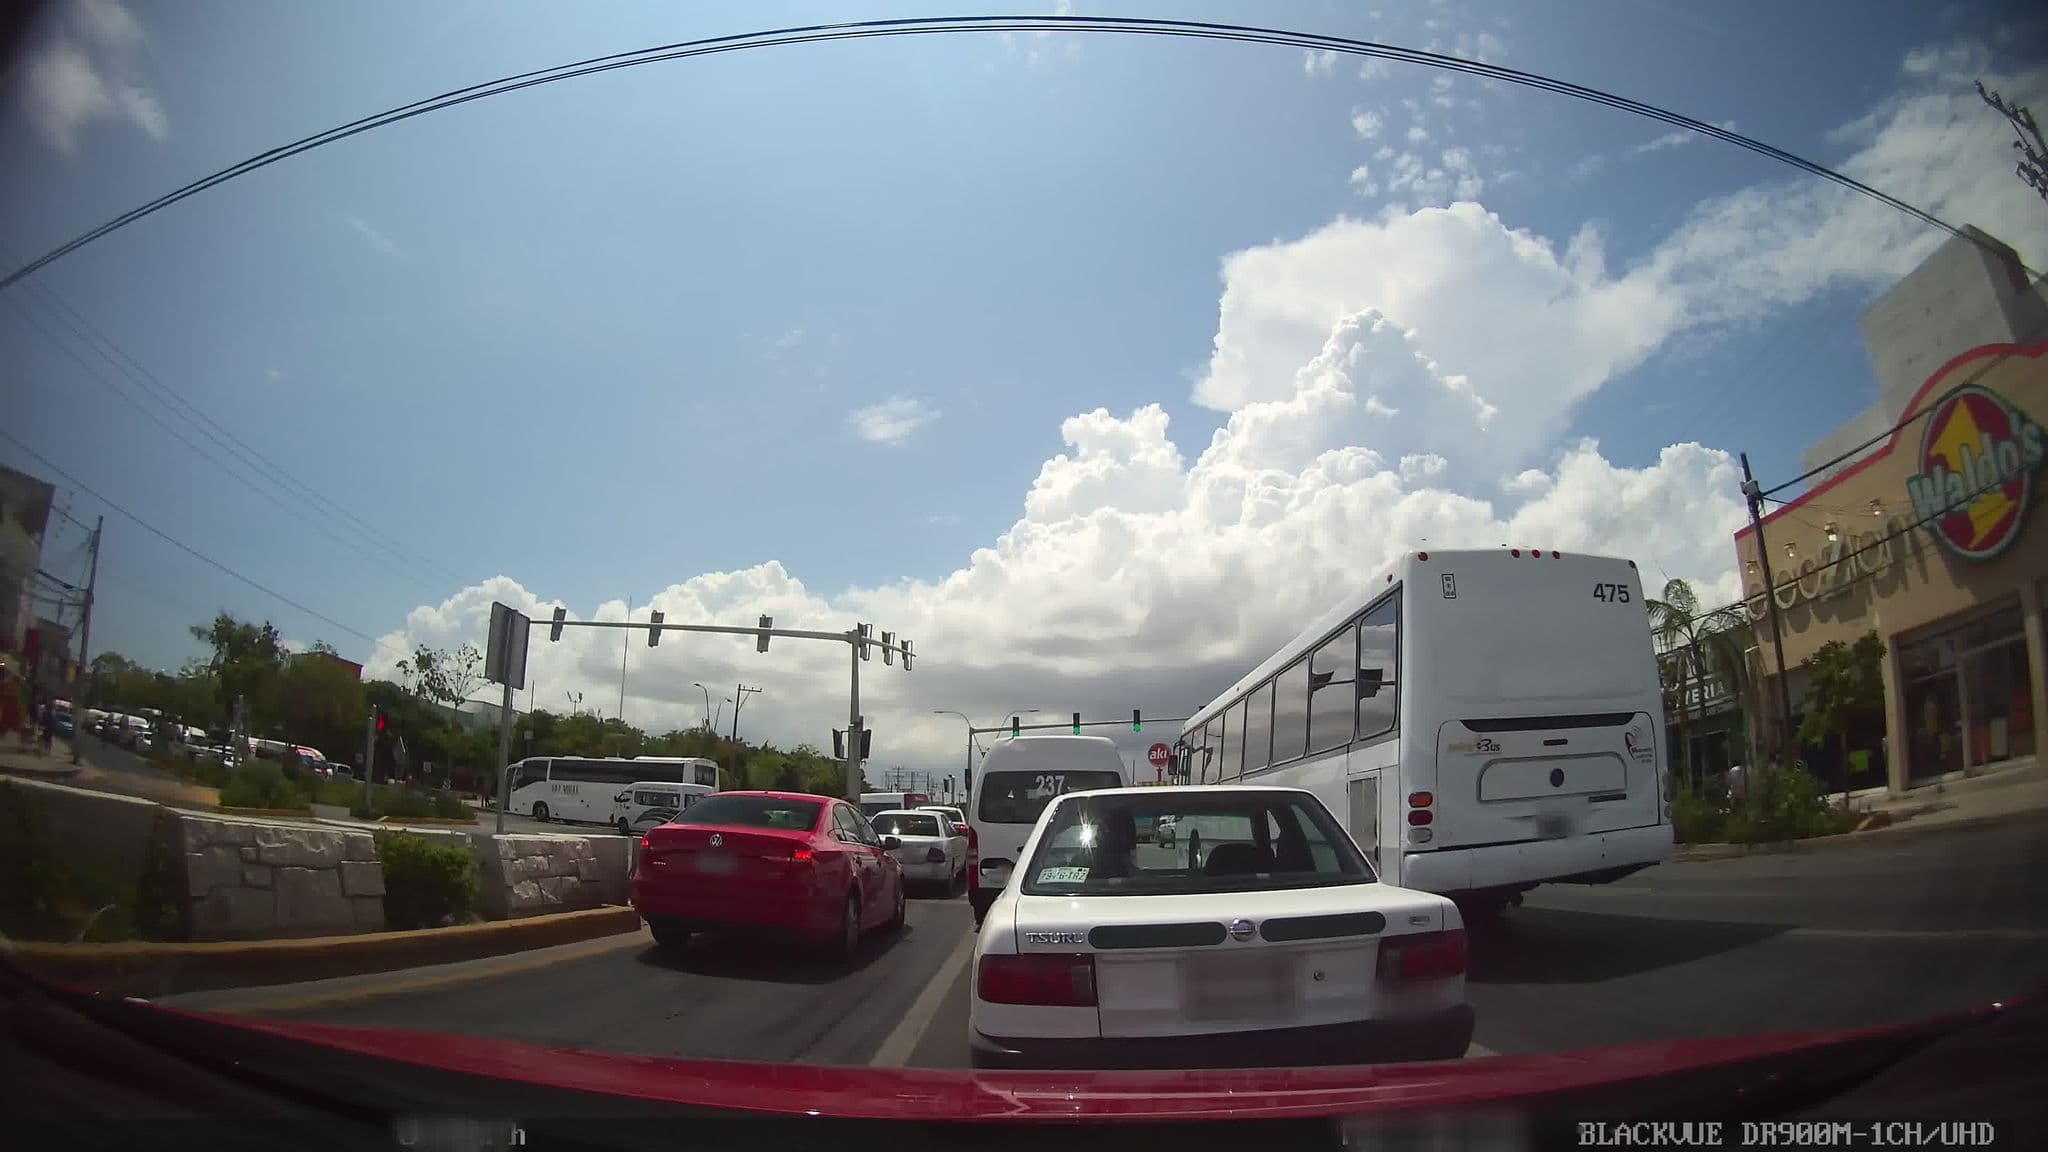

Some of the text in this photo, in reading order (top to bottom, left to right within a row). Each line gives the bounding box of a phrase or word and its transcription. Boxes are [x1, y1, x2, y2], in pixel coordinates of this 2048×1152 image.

[1907, 411, 2044, 528] Waldo's
[1593, 583, 1630, 603] 475
[1035, 775, 1065, 796] 237
[1025, 931, 1084, 944] TSURU
